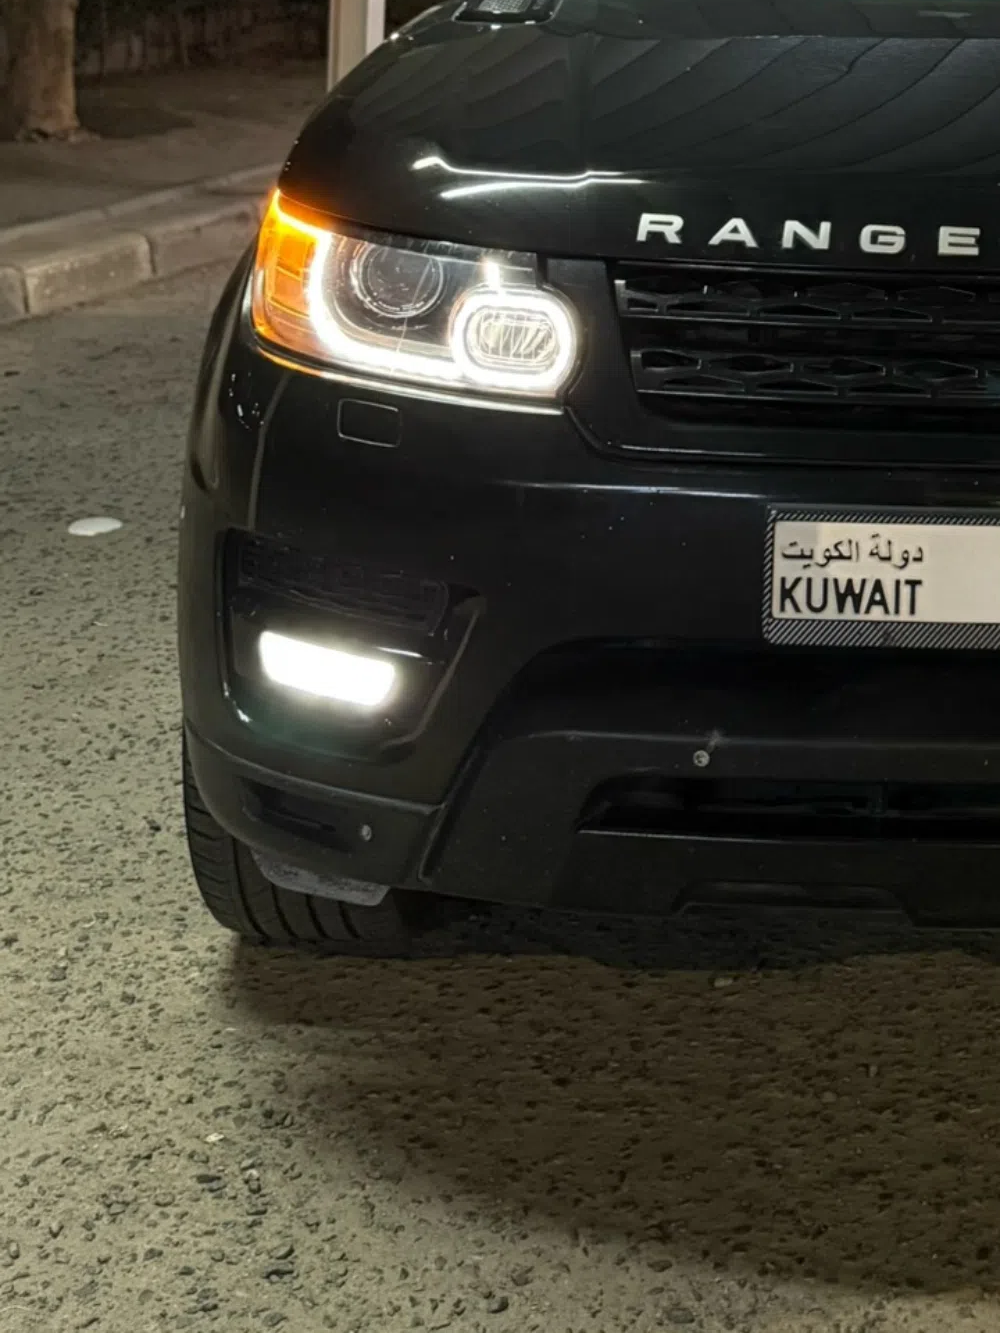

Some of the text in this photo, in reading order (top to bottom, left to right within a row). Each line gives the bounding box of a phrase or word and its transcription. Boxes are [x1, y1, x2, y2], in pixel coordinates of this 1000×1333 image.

[636, 211, 981, 257] RANGE
[780, 533, 924, 570] دولة الكويت
[779, 576, 923, 616] KUWAIT
